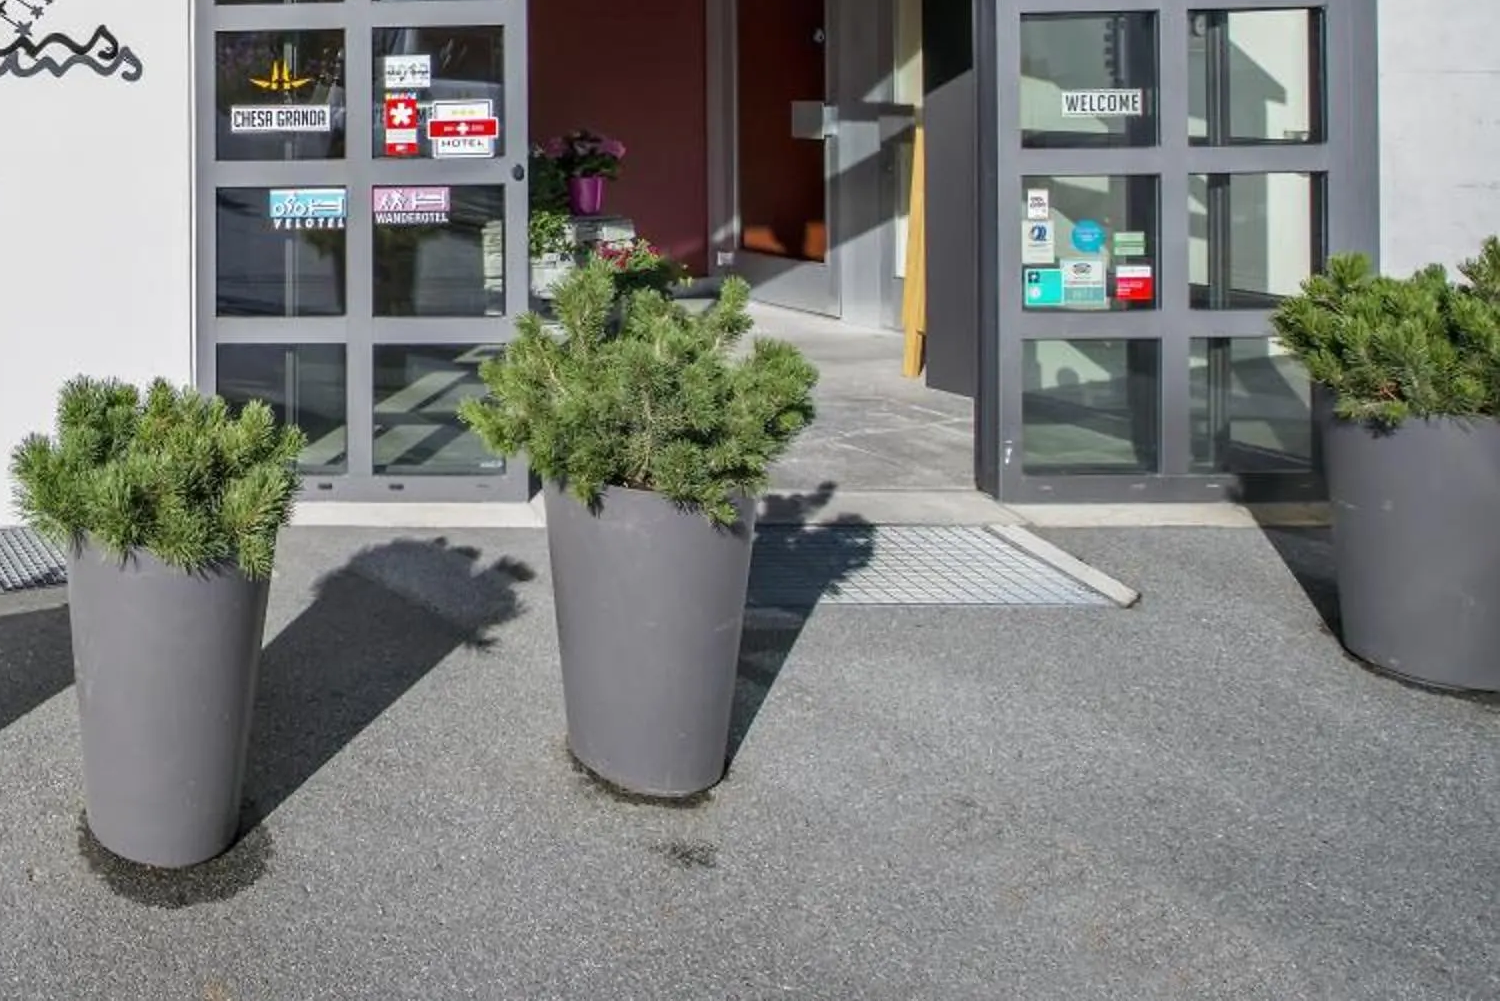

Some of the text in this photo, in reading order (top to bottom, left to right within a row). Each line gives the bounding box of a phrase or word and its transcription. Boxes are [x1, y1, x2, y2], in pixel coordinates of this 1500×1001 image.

[1065, 94, 1139, 112] WELCOME
[233, 109, 326, 128] CHESA GRANDA
[441, 138, 485, 148] HOTEL
[273, 217, 345, 230] VELOTEL
